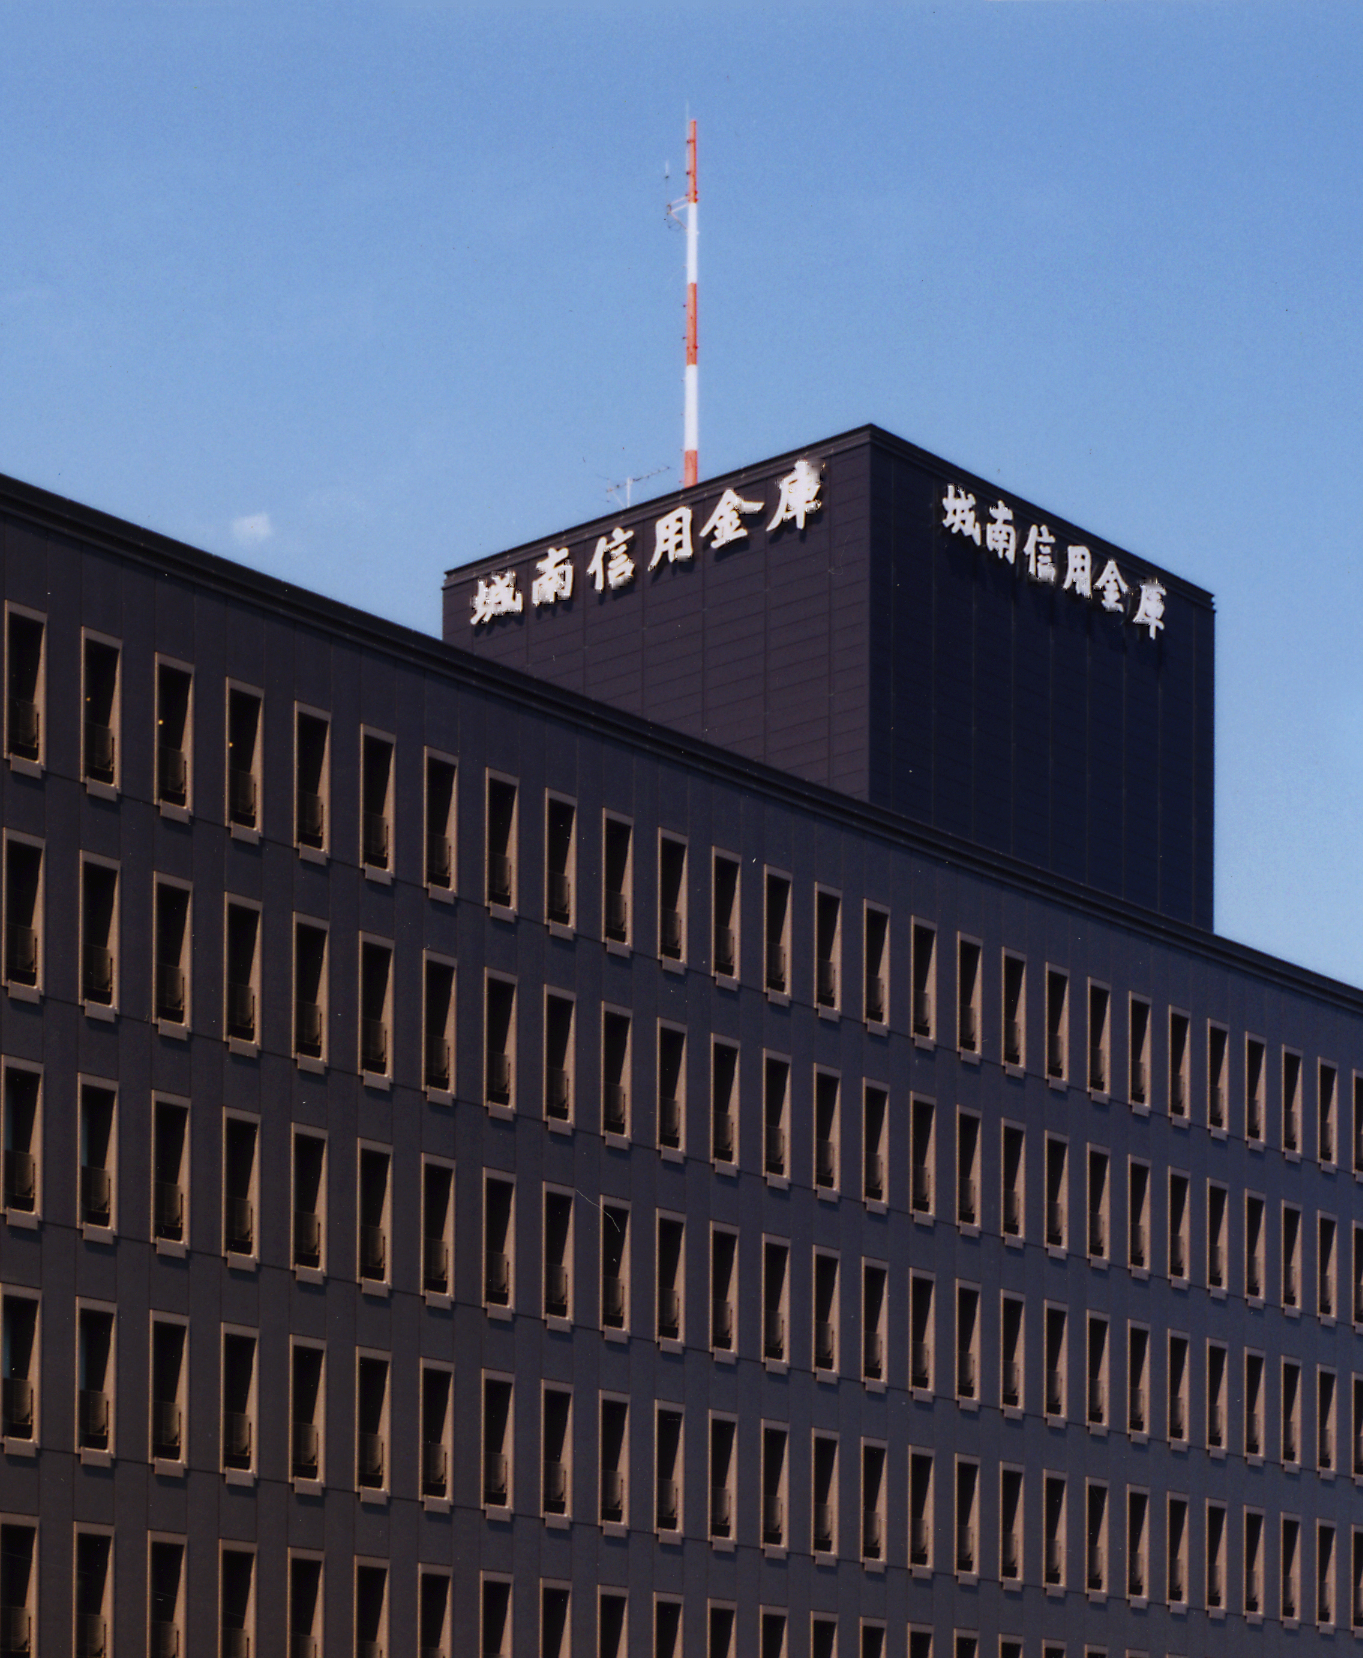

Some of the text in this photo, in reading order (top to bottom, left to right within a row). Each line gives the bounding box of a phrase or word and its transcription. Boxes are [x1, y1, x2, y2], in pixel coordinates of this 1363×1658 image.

[470, 459, 825, 625] 城南信用金庫
[942, 484, 1168, 639] 城南信用金庫
